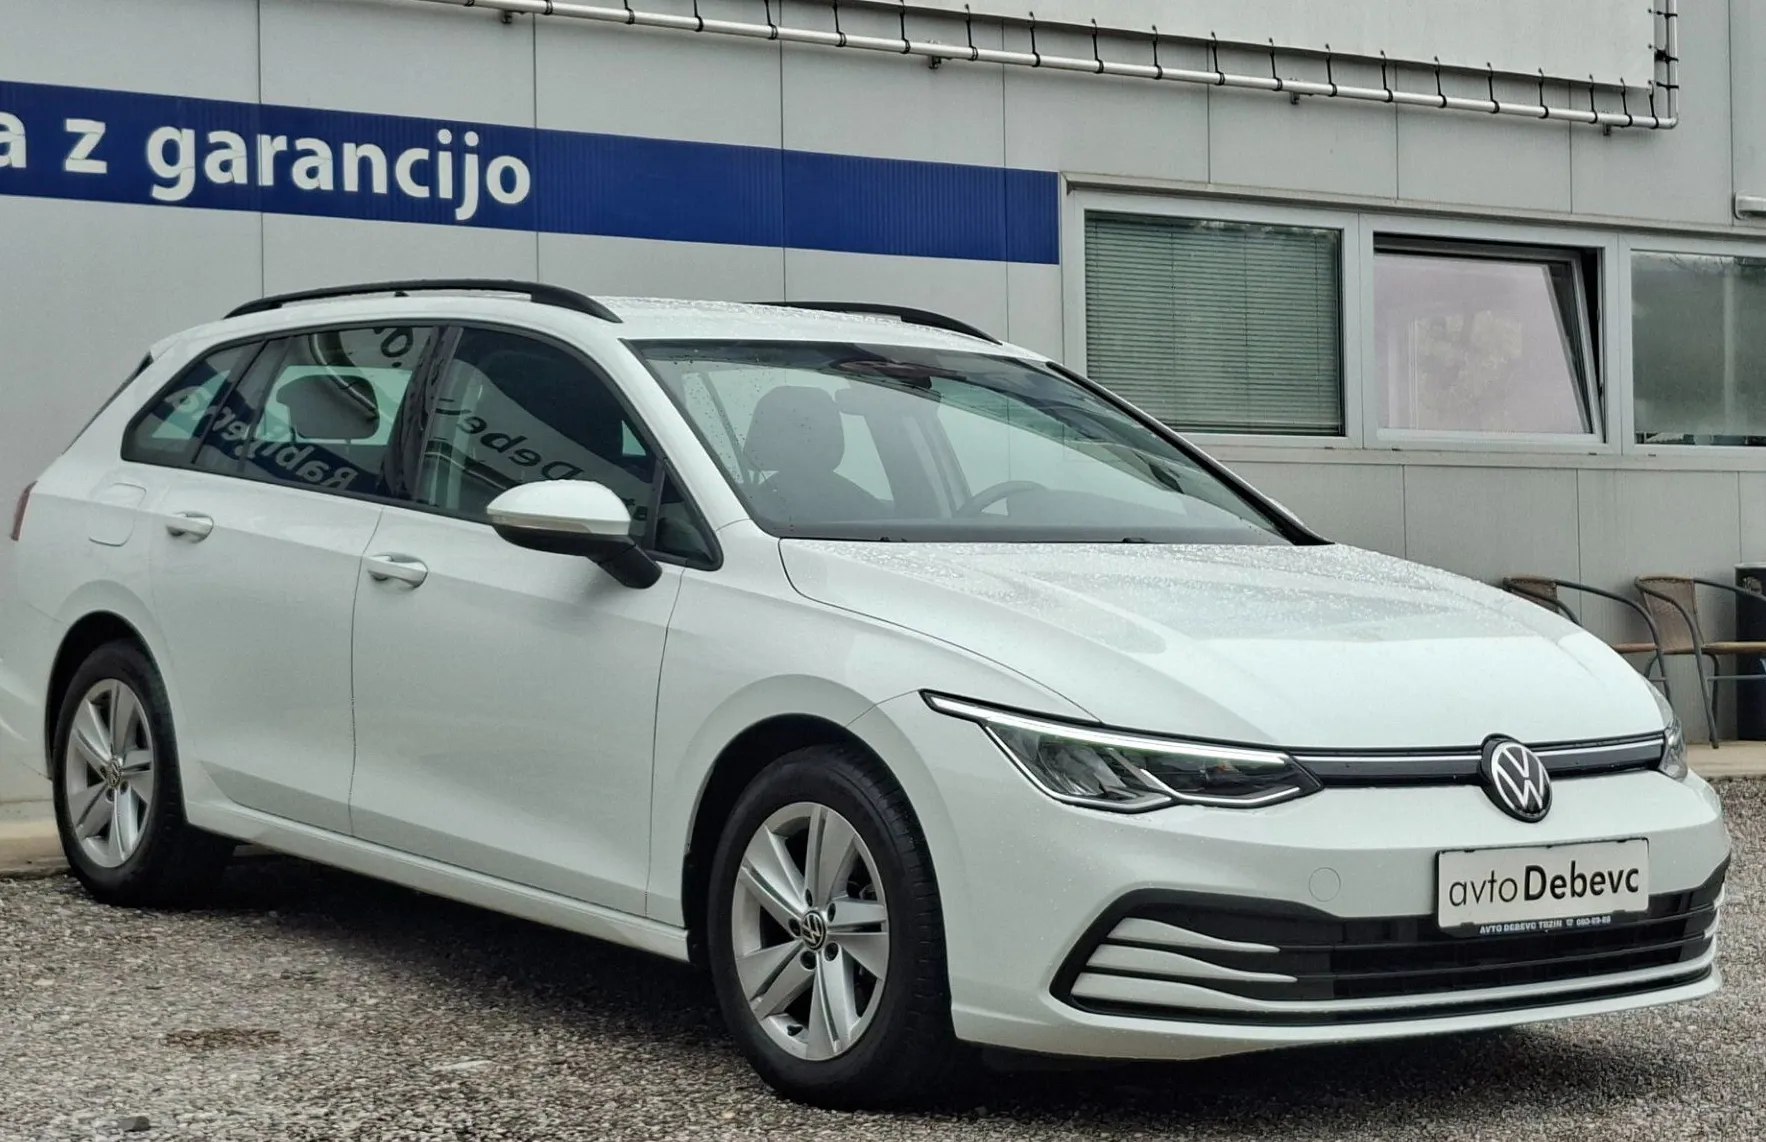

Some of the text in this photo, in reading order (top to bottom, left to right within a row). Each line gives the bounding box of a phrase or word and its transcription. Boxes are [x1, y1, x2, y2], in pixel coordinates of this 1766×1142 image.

[63, 117, 108, 174] z
[146, 125, 532, 221] garancijo
[1479, 924, 1503, 935] AVTO
